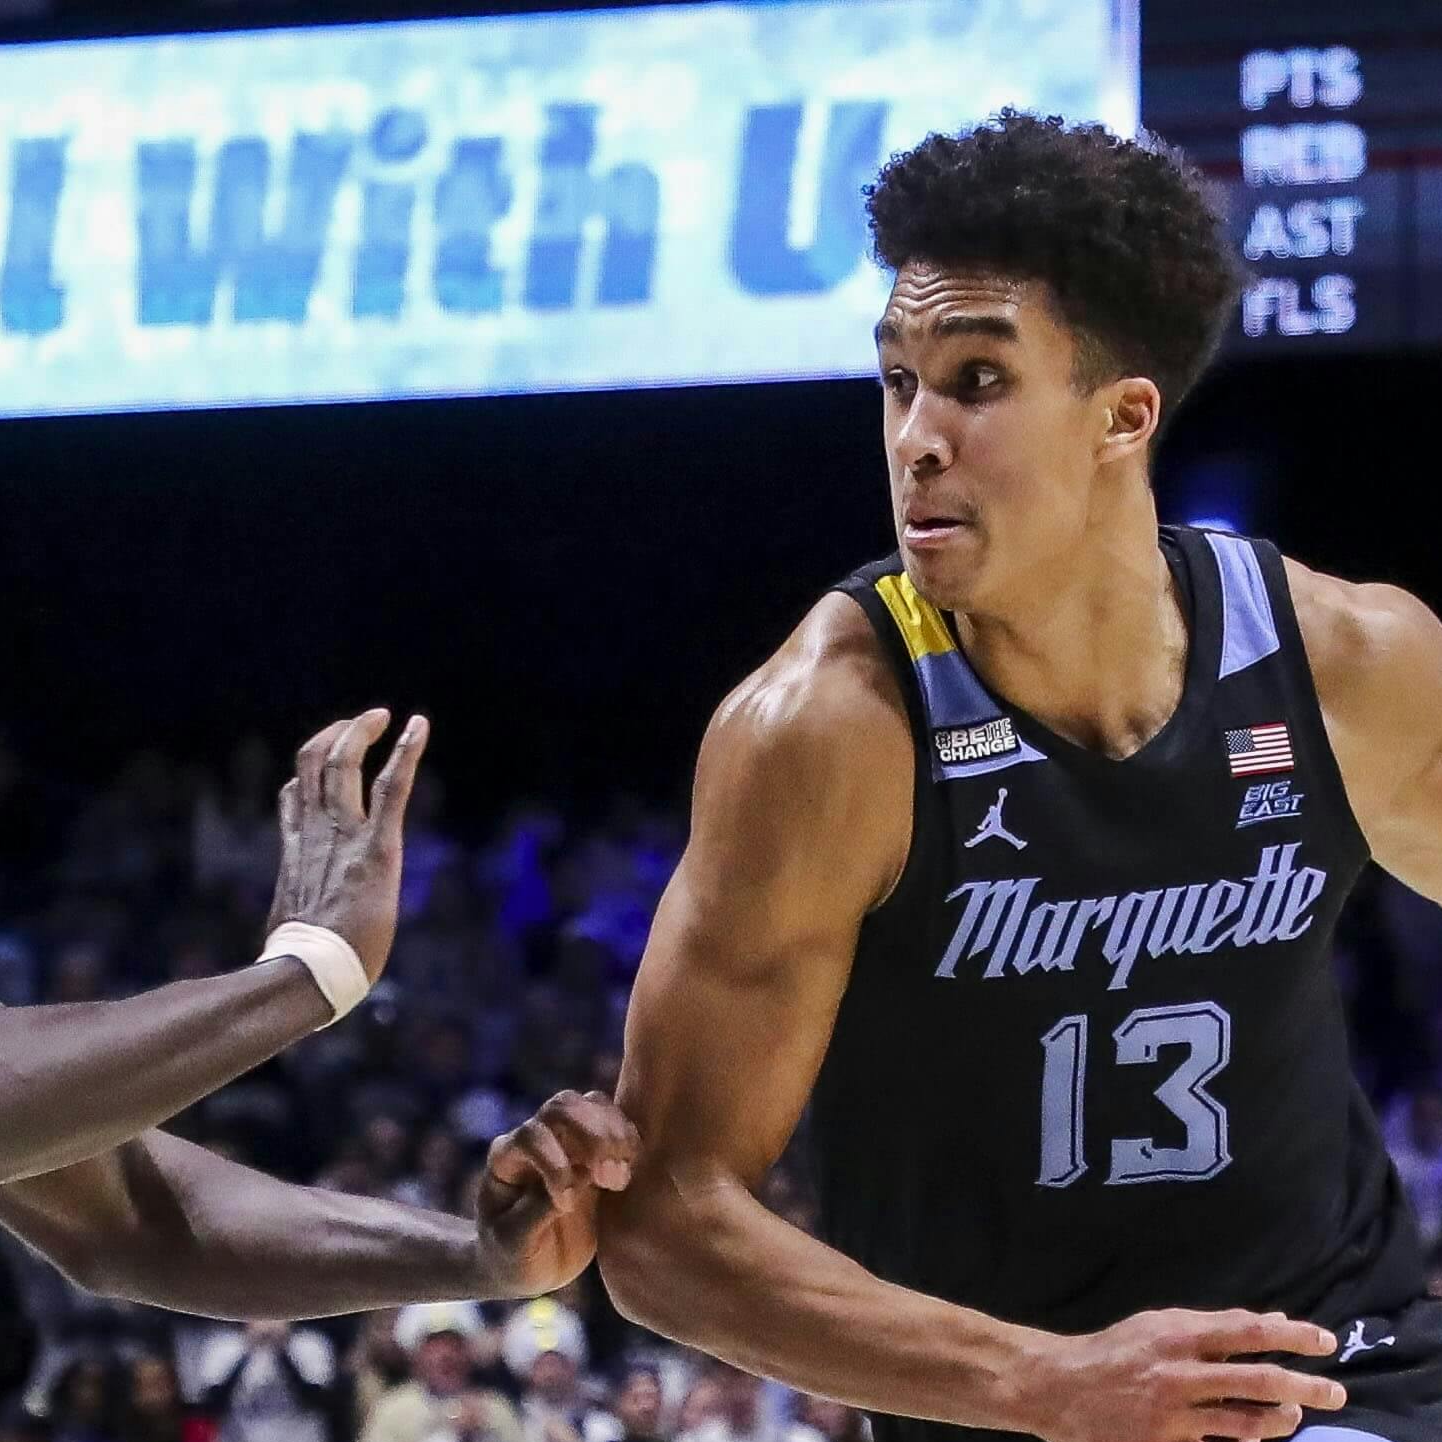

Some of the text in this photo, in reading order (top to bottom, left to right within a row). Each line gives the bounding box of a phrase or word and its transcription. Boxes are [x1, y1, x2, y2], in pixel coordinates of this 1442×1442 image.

[1240, 45, 1363, 110] PTS
[134, 100, 657, 327] With
[1244, 198, 1364, 261] AST
[939, 734, 1017, 763] CHANGE
[1239, 793, 1305, 819] EAST
[1244, 780, 1291, 802] BIG
[934, 842, 1327, 990] Marquette
[1034, 1000, 1234, 1188] 13
